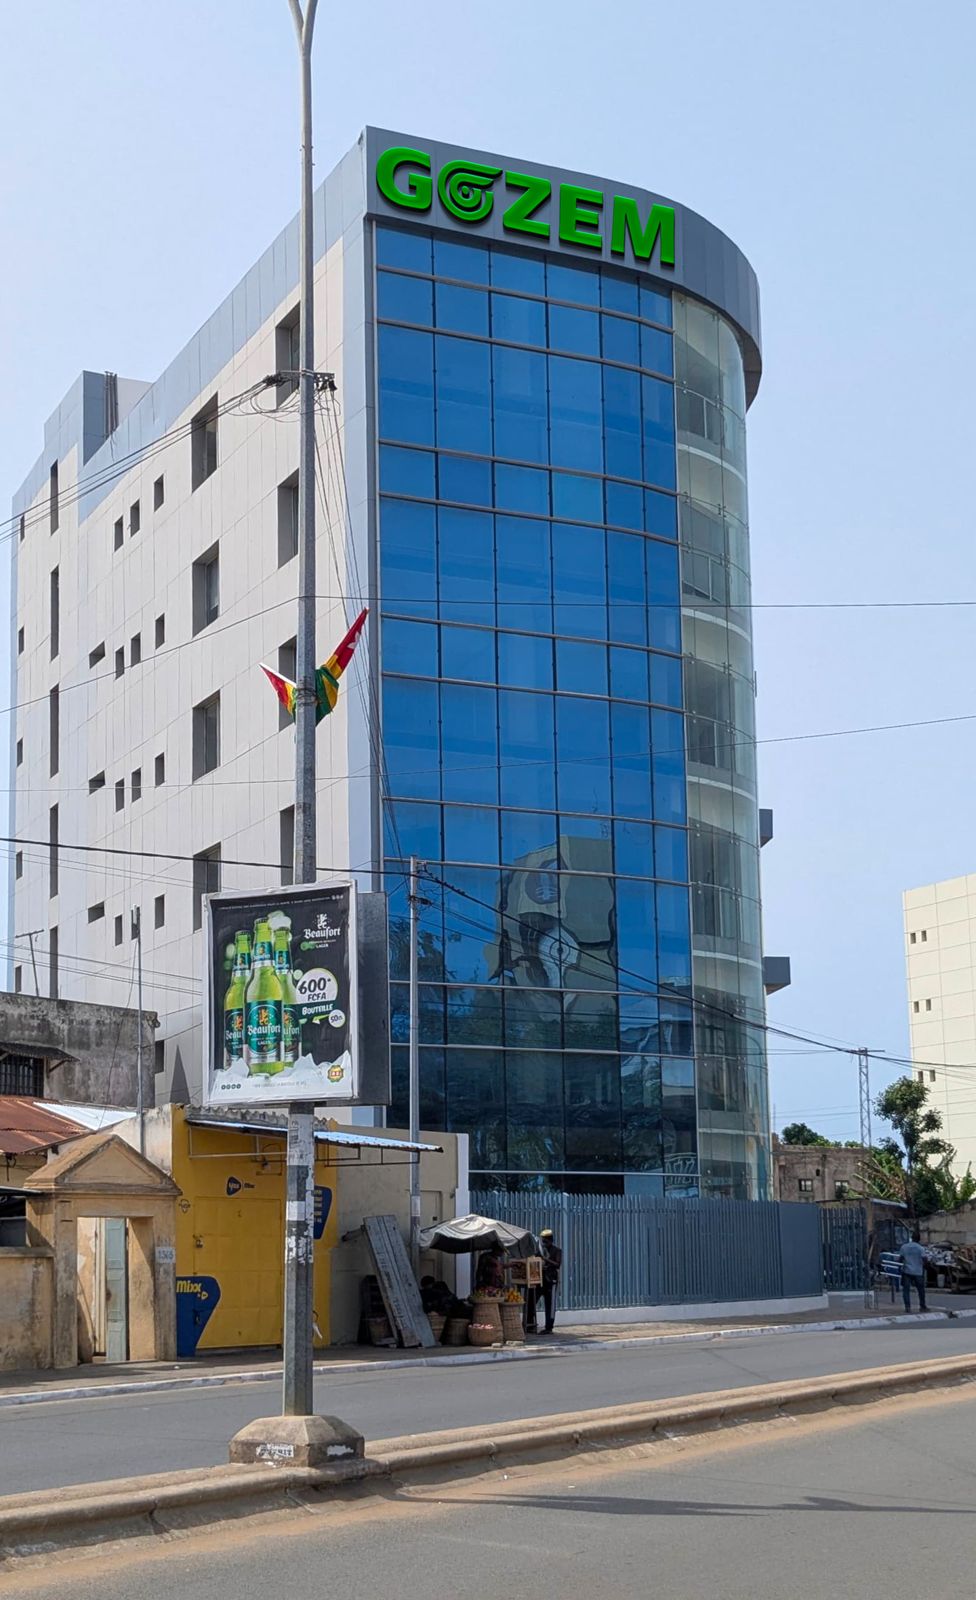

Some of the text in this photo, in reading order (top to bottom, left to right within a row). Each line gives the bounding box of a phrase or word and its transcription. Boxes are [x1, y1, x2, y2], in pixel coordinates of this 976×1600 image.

[376, 146, 677, 266] GOZEM
[303, 926, 341, 939] Beaufort
[307, 992, 327, 1002] FCFA
[247, 1023, 281, 1036] Beaufort
[176, 1280, 202, 1293] Mixx
